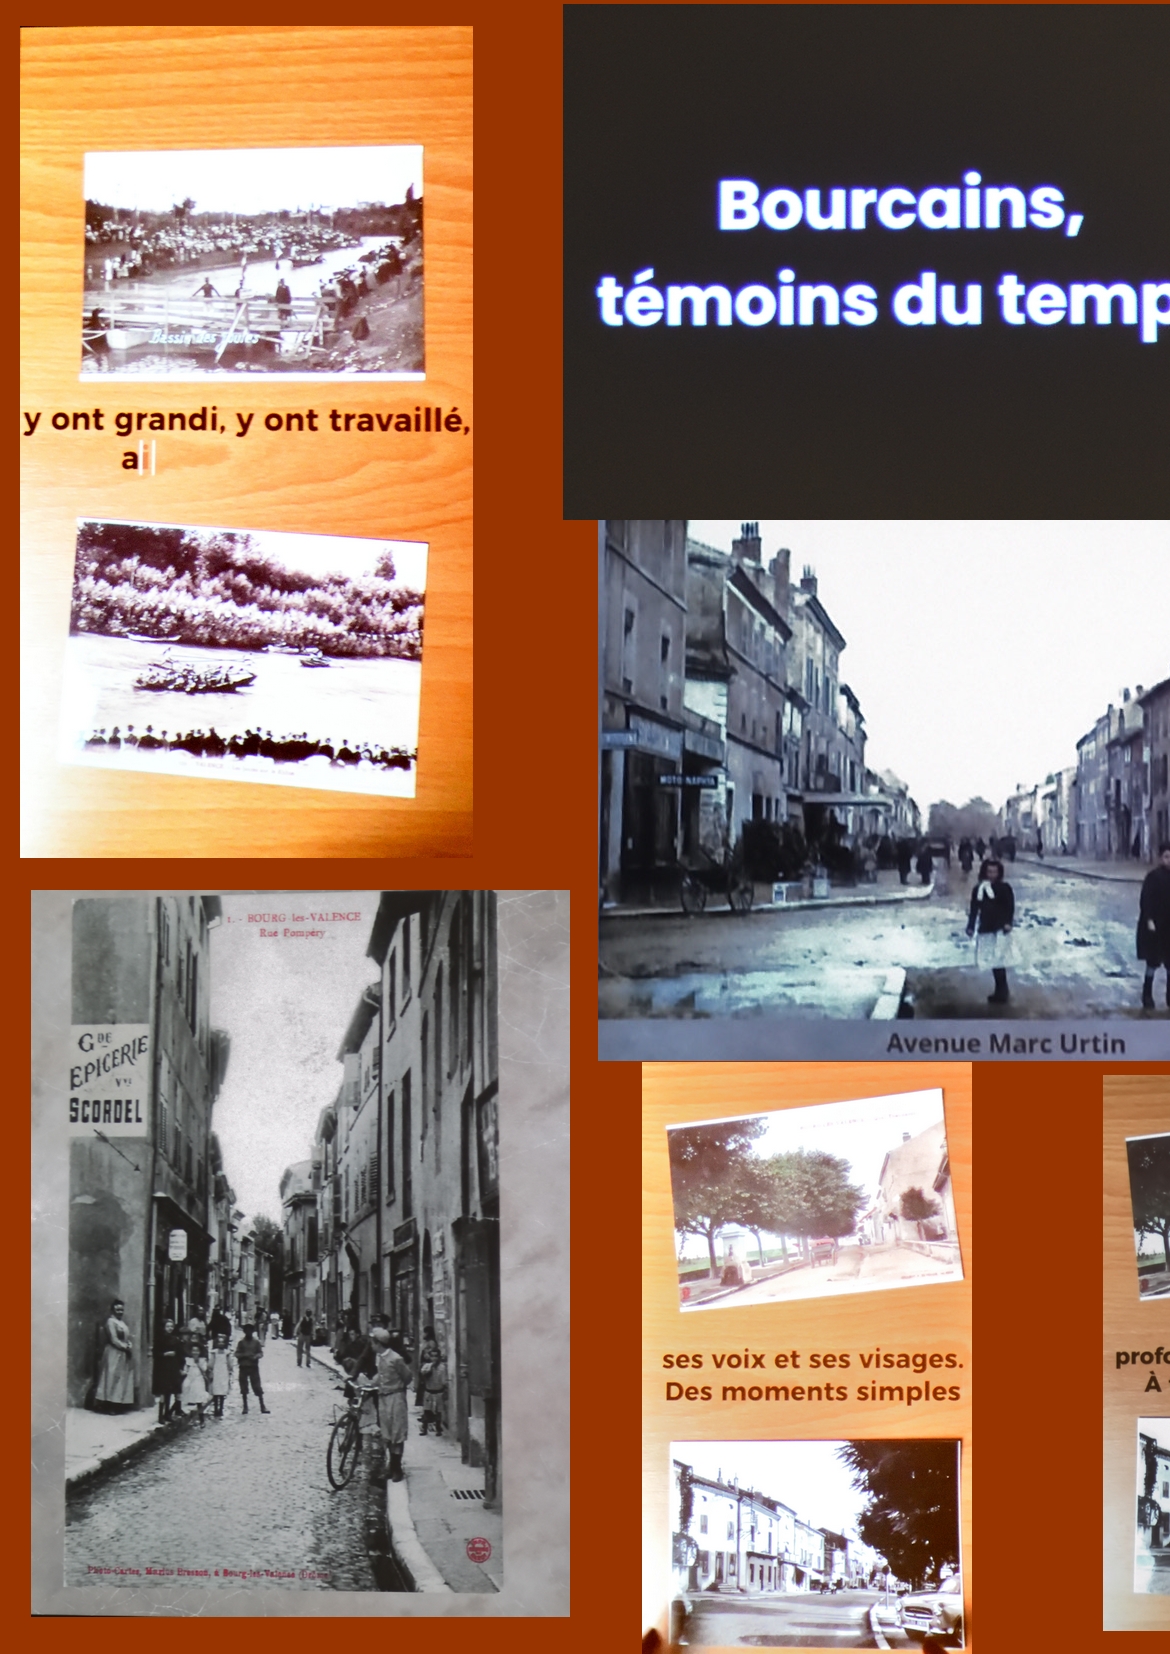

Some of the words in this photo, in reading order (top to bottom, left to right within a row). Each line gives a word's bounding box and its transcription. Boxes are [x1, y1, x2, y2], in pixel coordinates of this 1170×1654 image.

[718, 170, 1084, 237] Bourcains,
[596, 268, 879, 327] témoins
[893, 271, 983, 326] du
[23, 412, 41, 435] y
[51, 408, 105, 430] ont
[115, 407, 226, 437] grandi,
[236, 413, 255, 437] y
[264, 409, 318, 431] ont
[329, 407, 471, 436] travaillé,
[259, 928, 278, 937] Rue
[886, 1033, 981, 1054] Avenue
[989, 1033, 1052, 1054] Marc
[1060, 1033, 1126, 1054] Urtin
[70, 1036, 148, 1090] EPICERIE
[69, 1097, 142, 1123] SCORDEL
[662, 1352, 703, 1370] ses
[711, 1348, 766, 1369] voix
[774, 1349, 801, 1369] et
[808, 1352, 851, 1369] ses
[859, 1347, 964, 1374] visages.
[665, 1382, 712, 1402] Des
[721, 1384, 849, 1402] moments
[856, 1380, 962, 1406] simples
[1144, 1371, 1162, 1393] À
